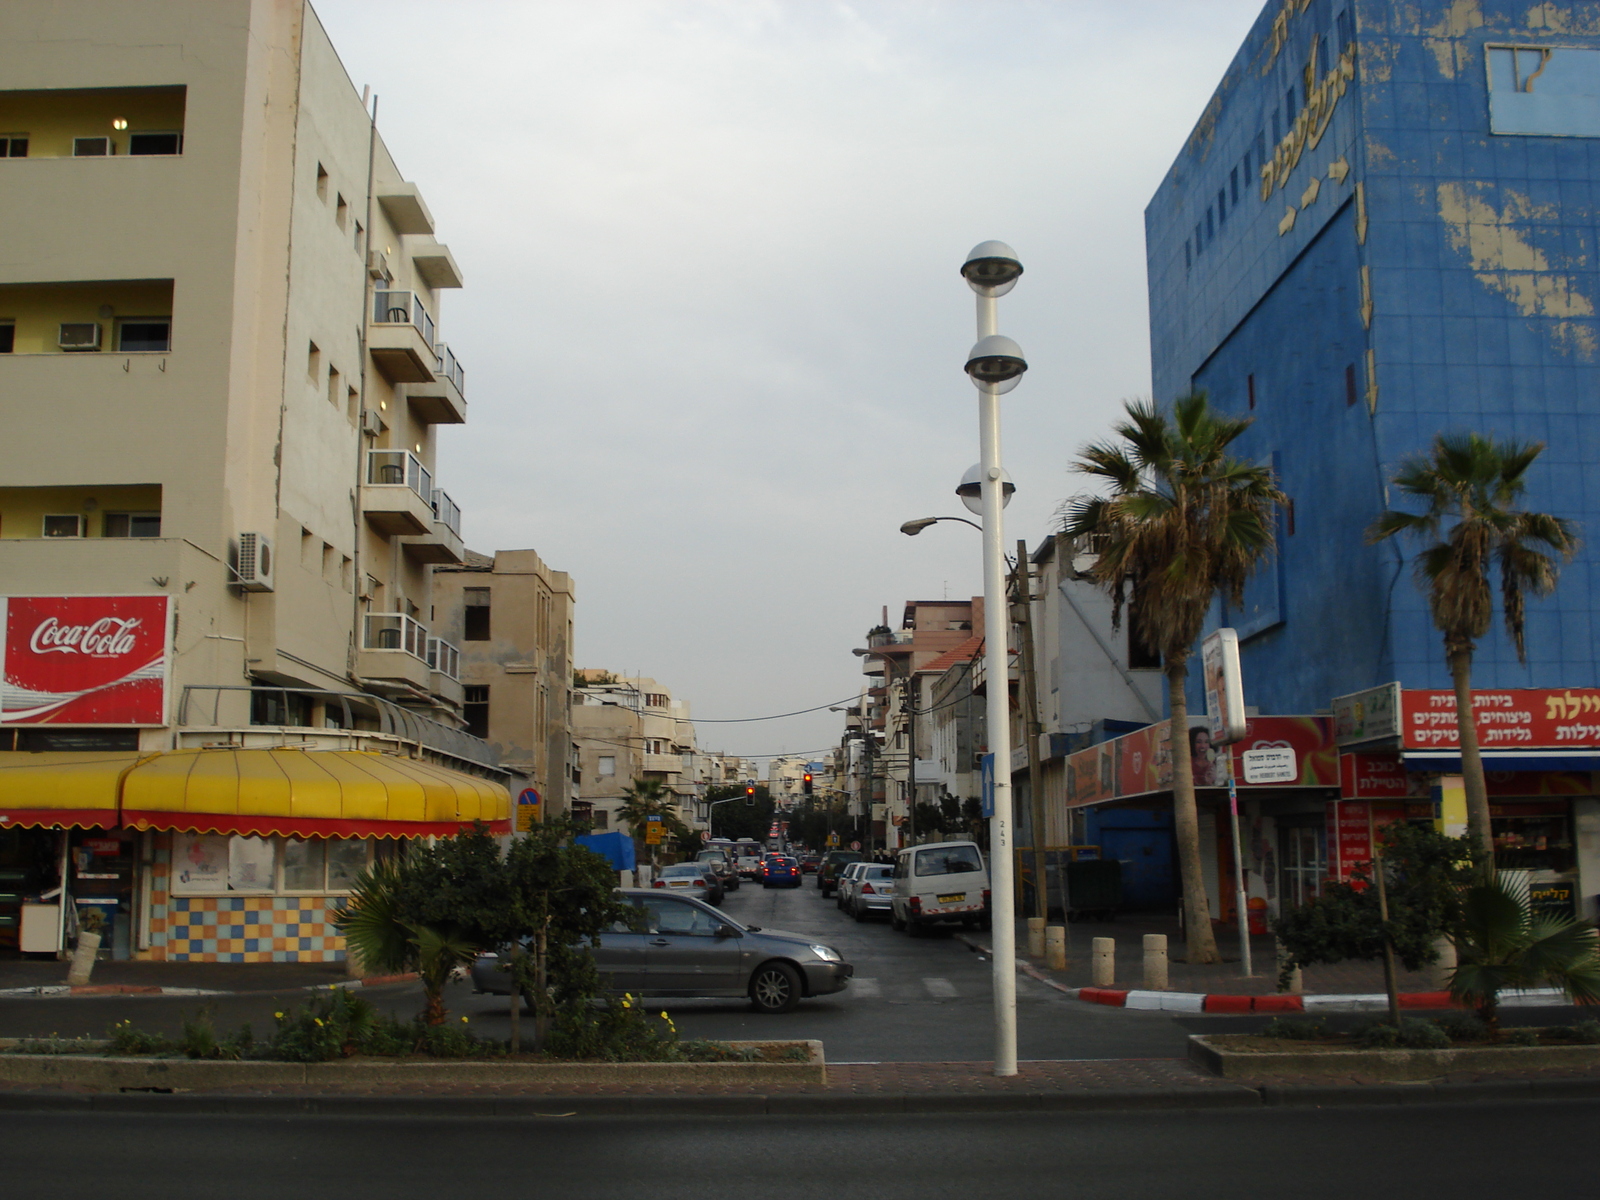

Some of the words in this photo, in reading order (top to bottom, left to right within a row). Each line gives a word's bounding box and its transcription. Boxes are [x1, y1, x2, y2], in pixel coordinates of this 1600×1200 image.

[30, 617, 143, 654] Coca-Cola
[1430, 695, 1458, 707] תיה
[1413, 711, 1459, 727] מתקים
[1477, 711, 1532, 727] פיצוחים,
[1414, 729, 1460, 745] טיקים
[1484, 727, 1532, 744] גלידות,
[1367, 761, 1396, 773] כוכב
[1360, 775, 1404, 789] הטיילת
